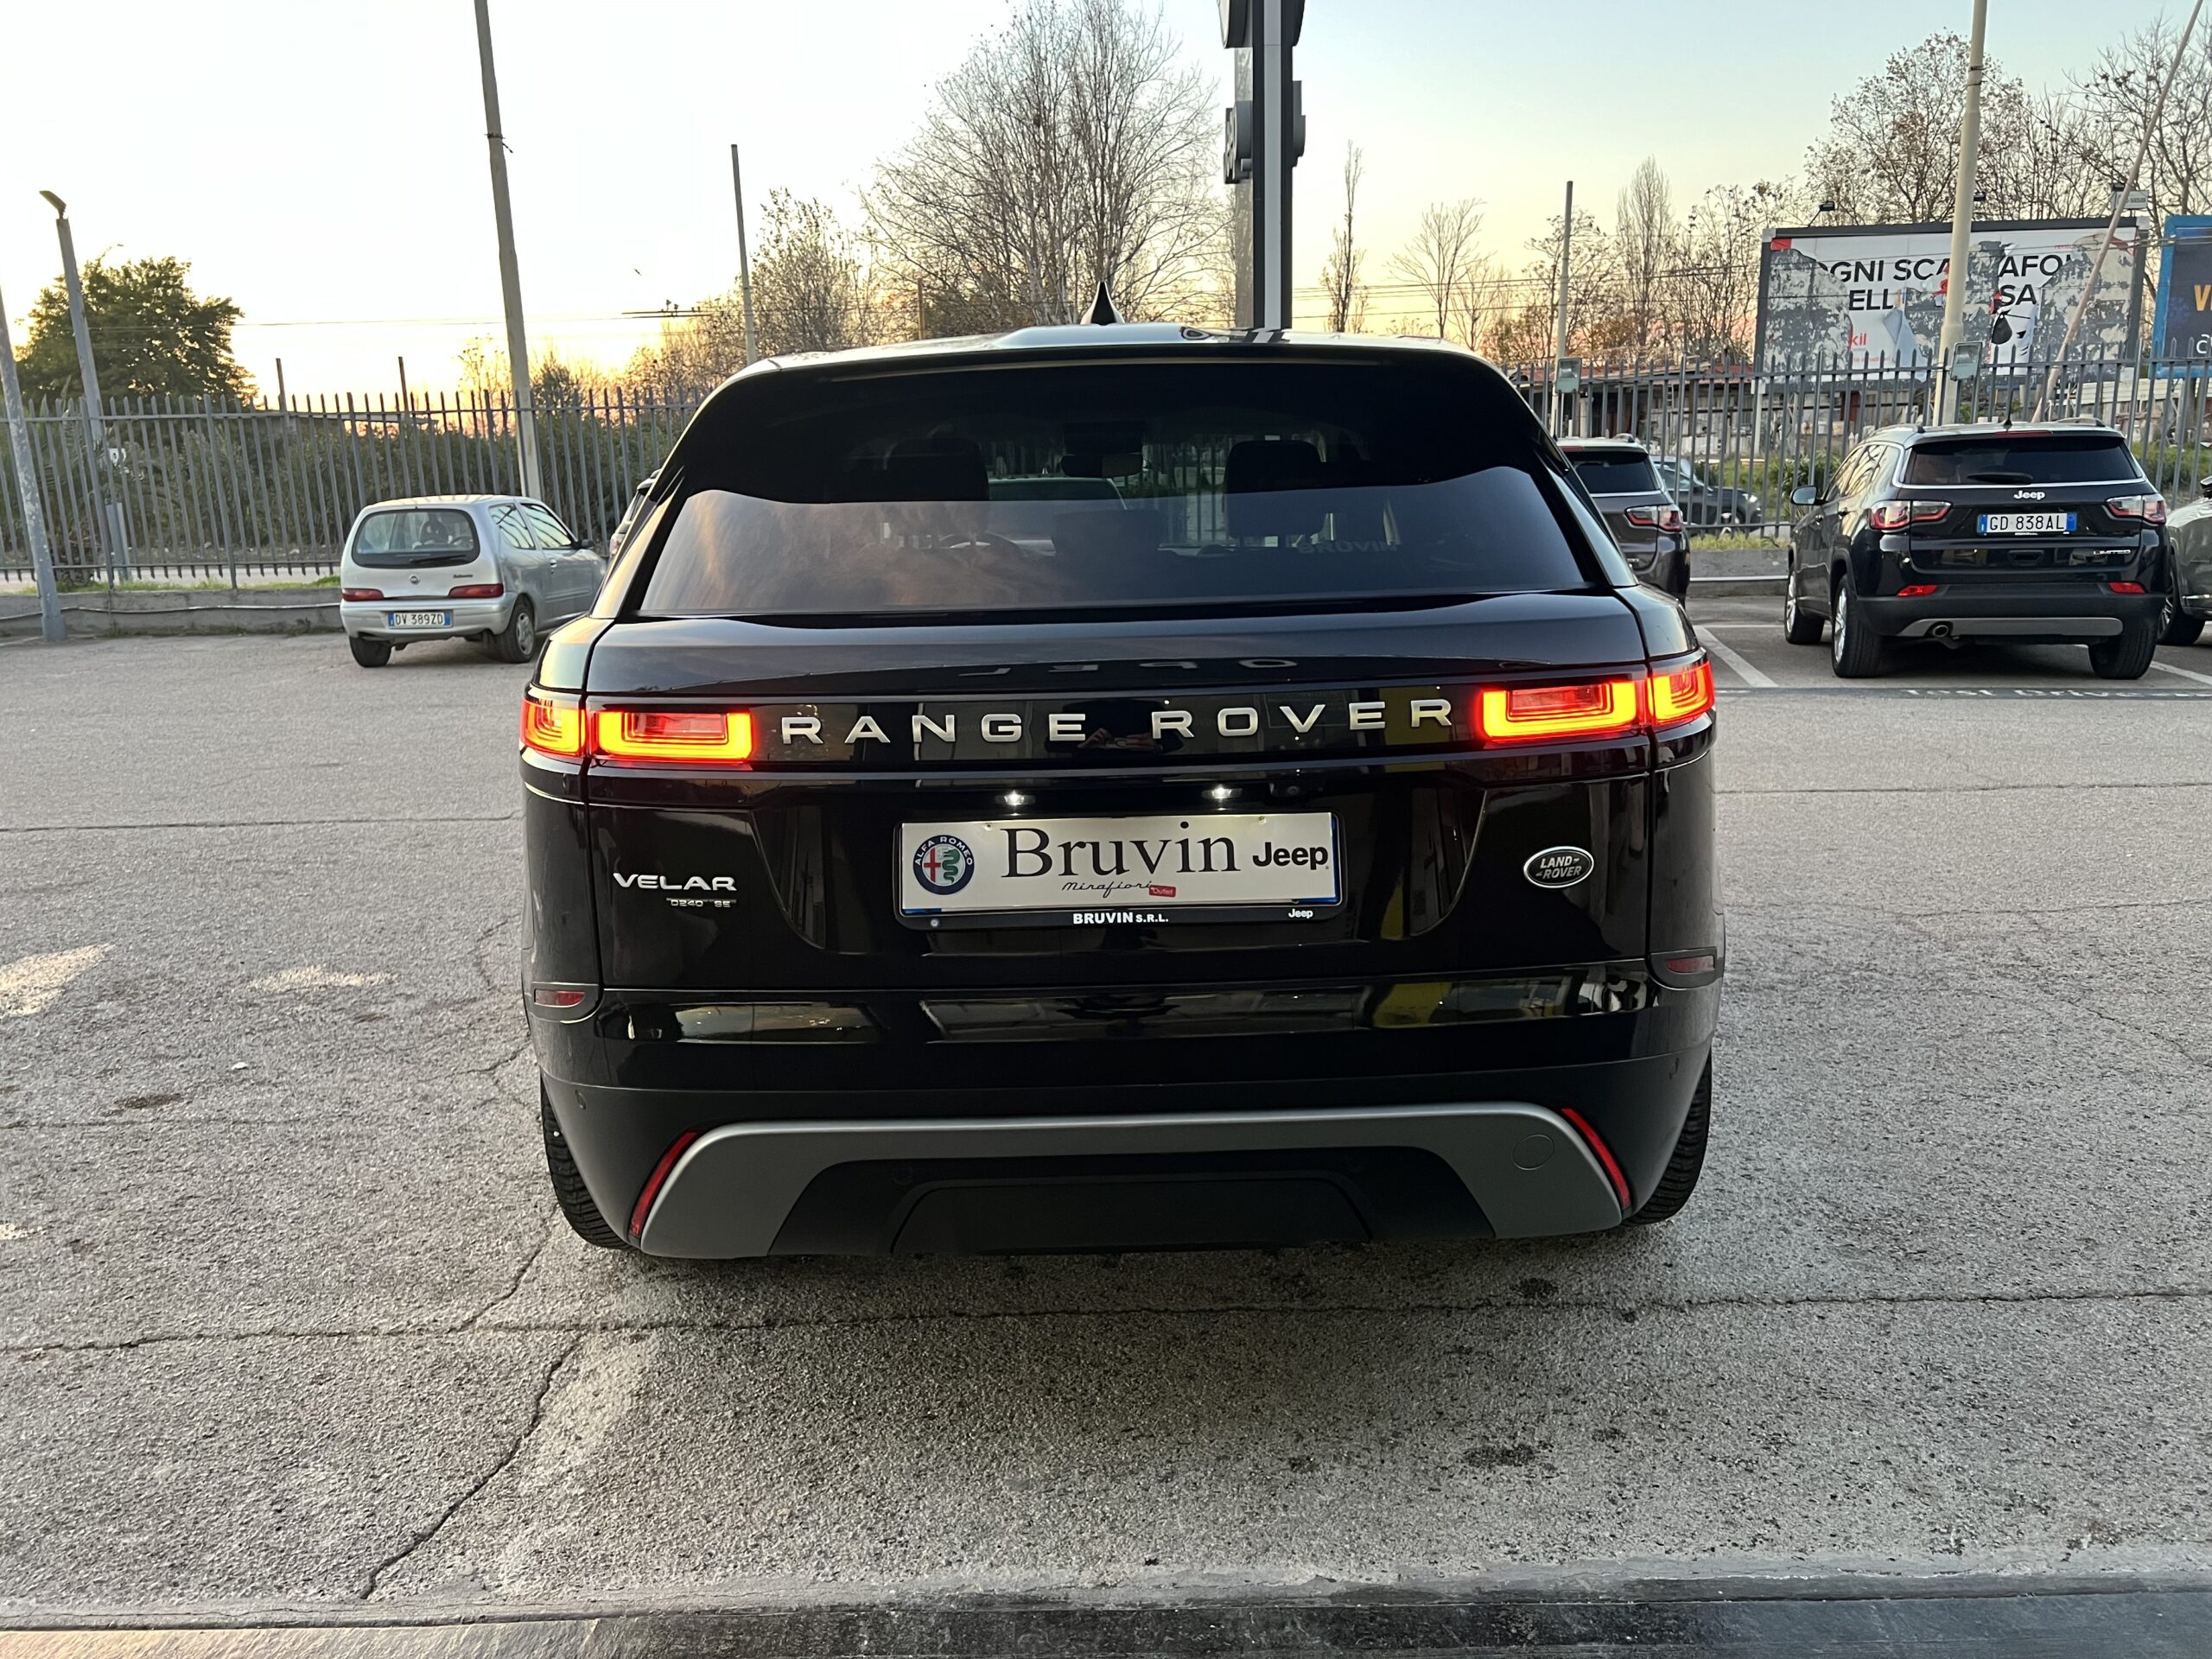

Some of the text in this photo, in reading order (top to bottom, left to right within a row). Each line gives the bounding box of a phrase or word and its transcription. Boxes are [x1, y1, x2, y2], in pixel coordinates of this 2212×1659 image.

[1816, 261, 1885, 283] GNI
[1849, 289, 1894, 310] ELL
[2195, 284, 2212, 312] V
[2014, 490, 2045, 500] Jeep
[1990, 515, 2065, 531] GD 838AL
[395, 613, 444, 625] DV 389ZD
[781, 698, 1452, 745] RANGE ROVER
[914, 836, 973, 866] ALFA ROMEO
[999, 821, 1329, 878] Bruvin Jeep
[613, 873, 737, 892] VELAR
[1061, 880, 1153, 899] Mirafiori
[670, 899, 704, 908] D240
[1072, 912, 1134, 925] BRUVIN
[1287, 908, 1314, 919] Jeep
